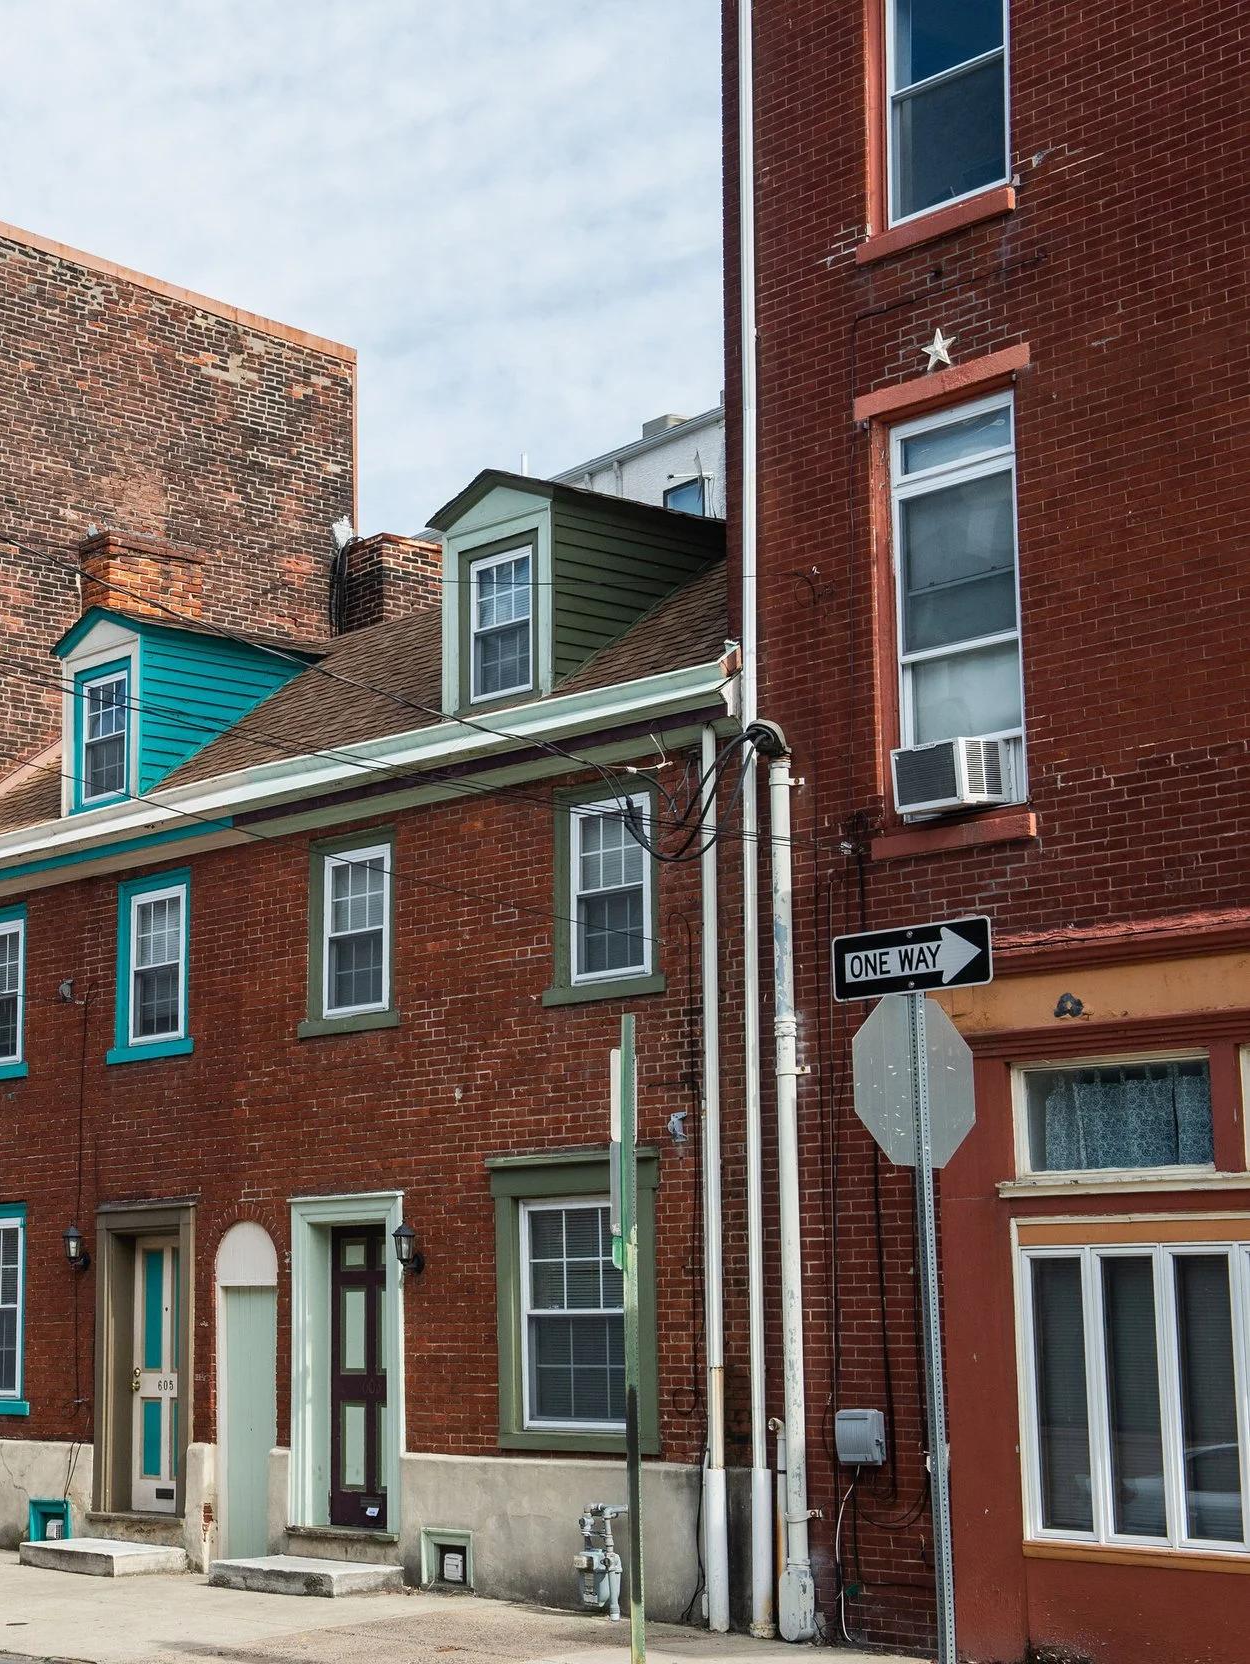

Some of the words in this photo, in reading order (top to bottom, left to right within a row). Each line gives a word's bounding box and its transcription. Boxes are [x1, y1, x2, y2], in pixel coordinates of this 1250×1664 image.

[850, 951, 891, 979] ONE
[897, 944, 942, 973] WAY
[157, 1380, 174, 1391] 605
